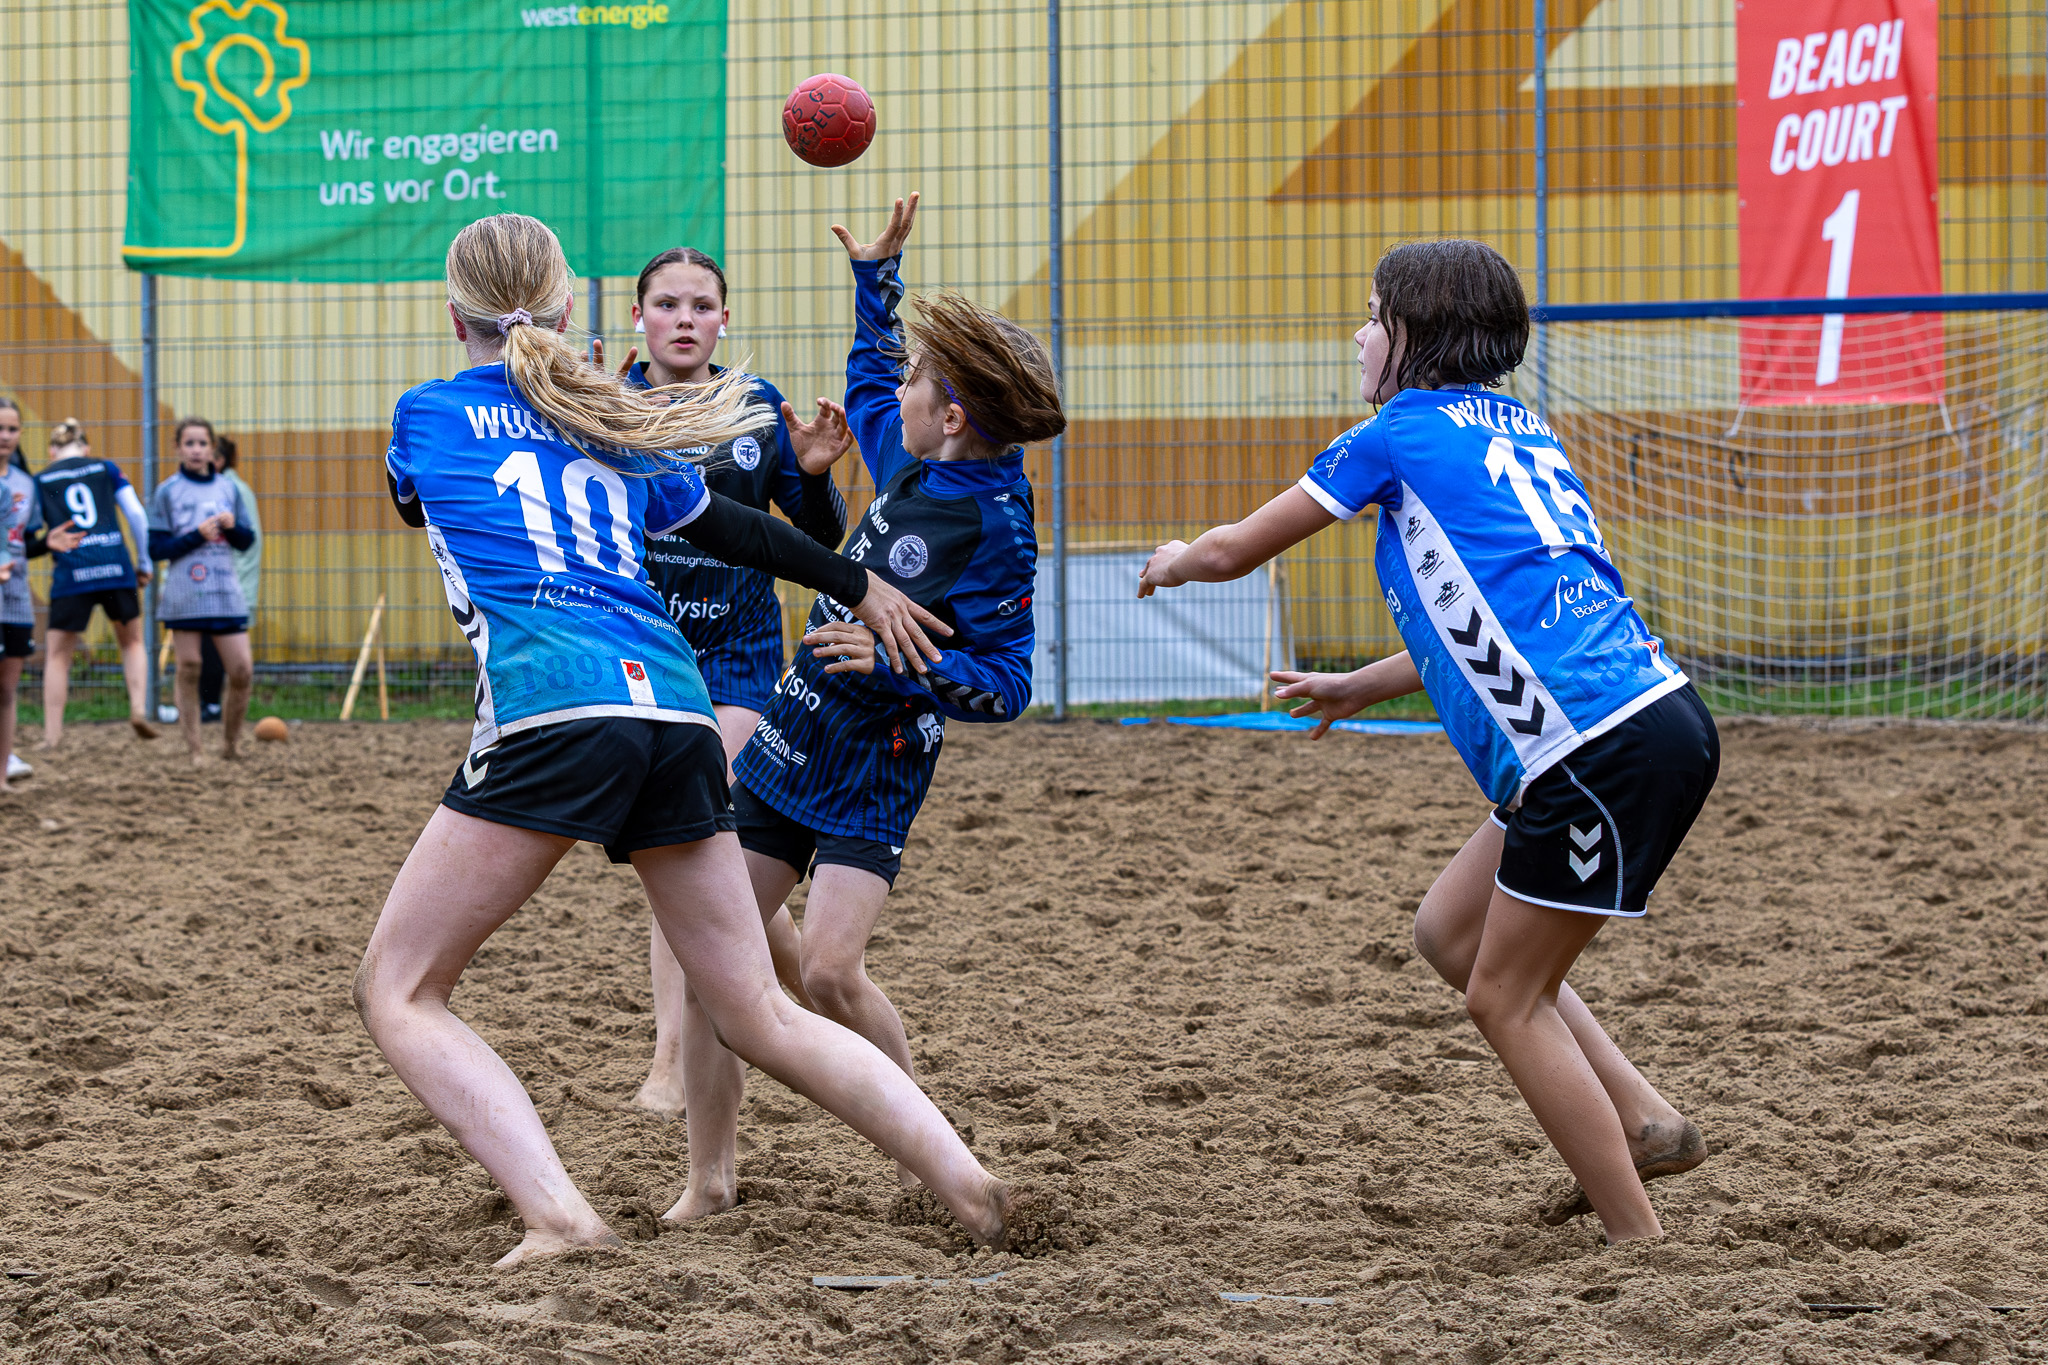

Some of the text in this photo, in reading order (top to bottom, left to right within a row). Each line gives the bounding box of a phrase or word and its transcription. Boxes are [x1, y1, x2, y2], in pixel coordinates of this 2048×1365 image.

[521, 0, 669, 30] westenergie
[1768, 18, 1905, 99] BEACH
[320, 123, 559, 164] Wir engagieren
[1770, 95, 1908, 176] COURT
[319, 168, 507, 206] uns vor Ort.
[1815, 189, 1861, 387] 1
[1437, 394, 1559, 443] WÜLFRA
[65, 483, 98, 529] 9
[492, 451, 642, 580] 10
[1484, 437, 1612, 565] 15
[517, 653, 629, 695] 1891
